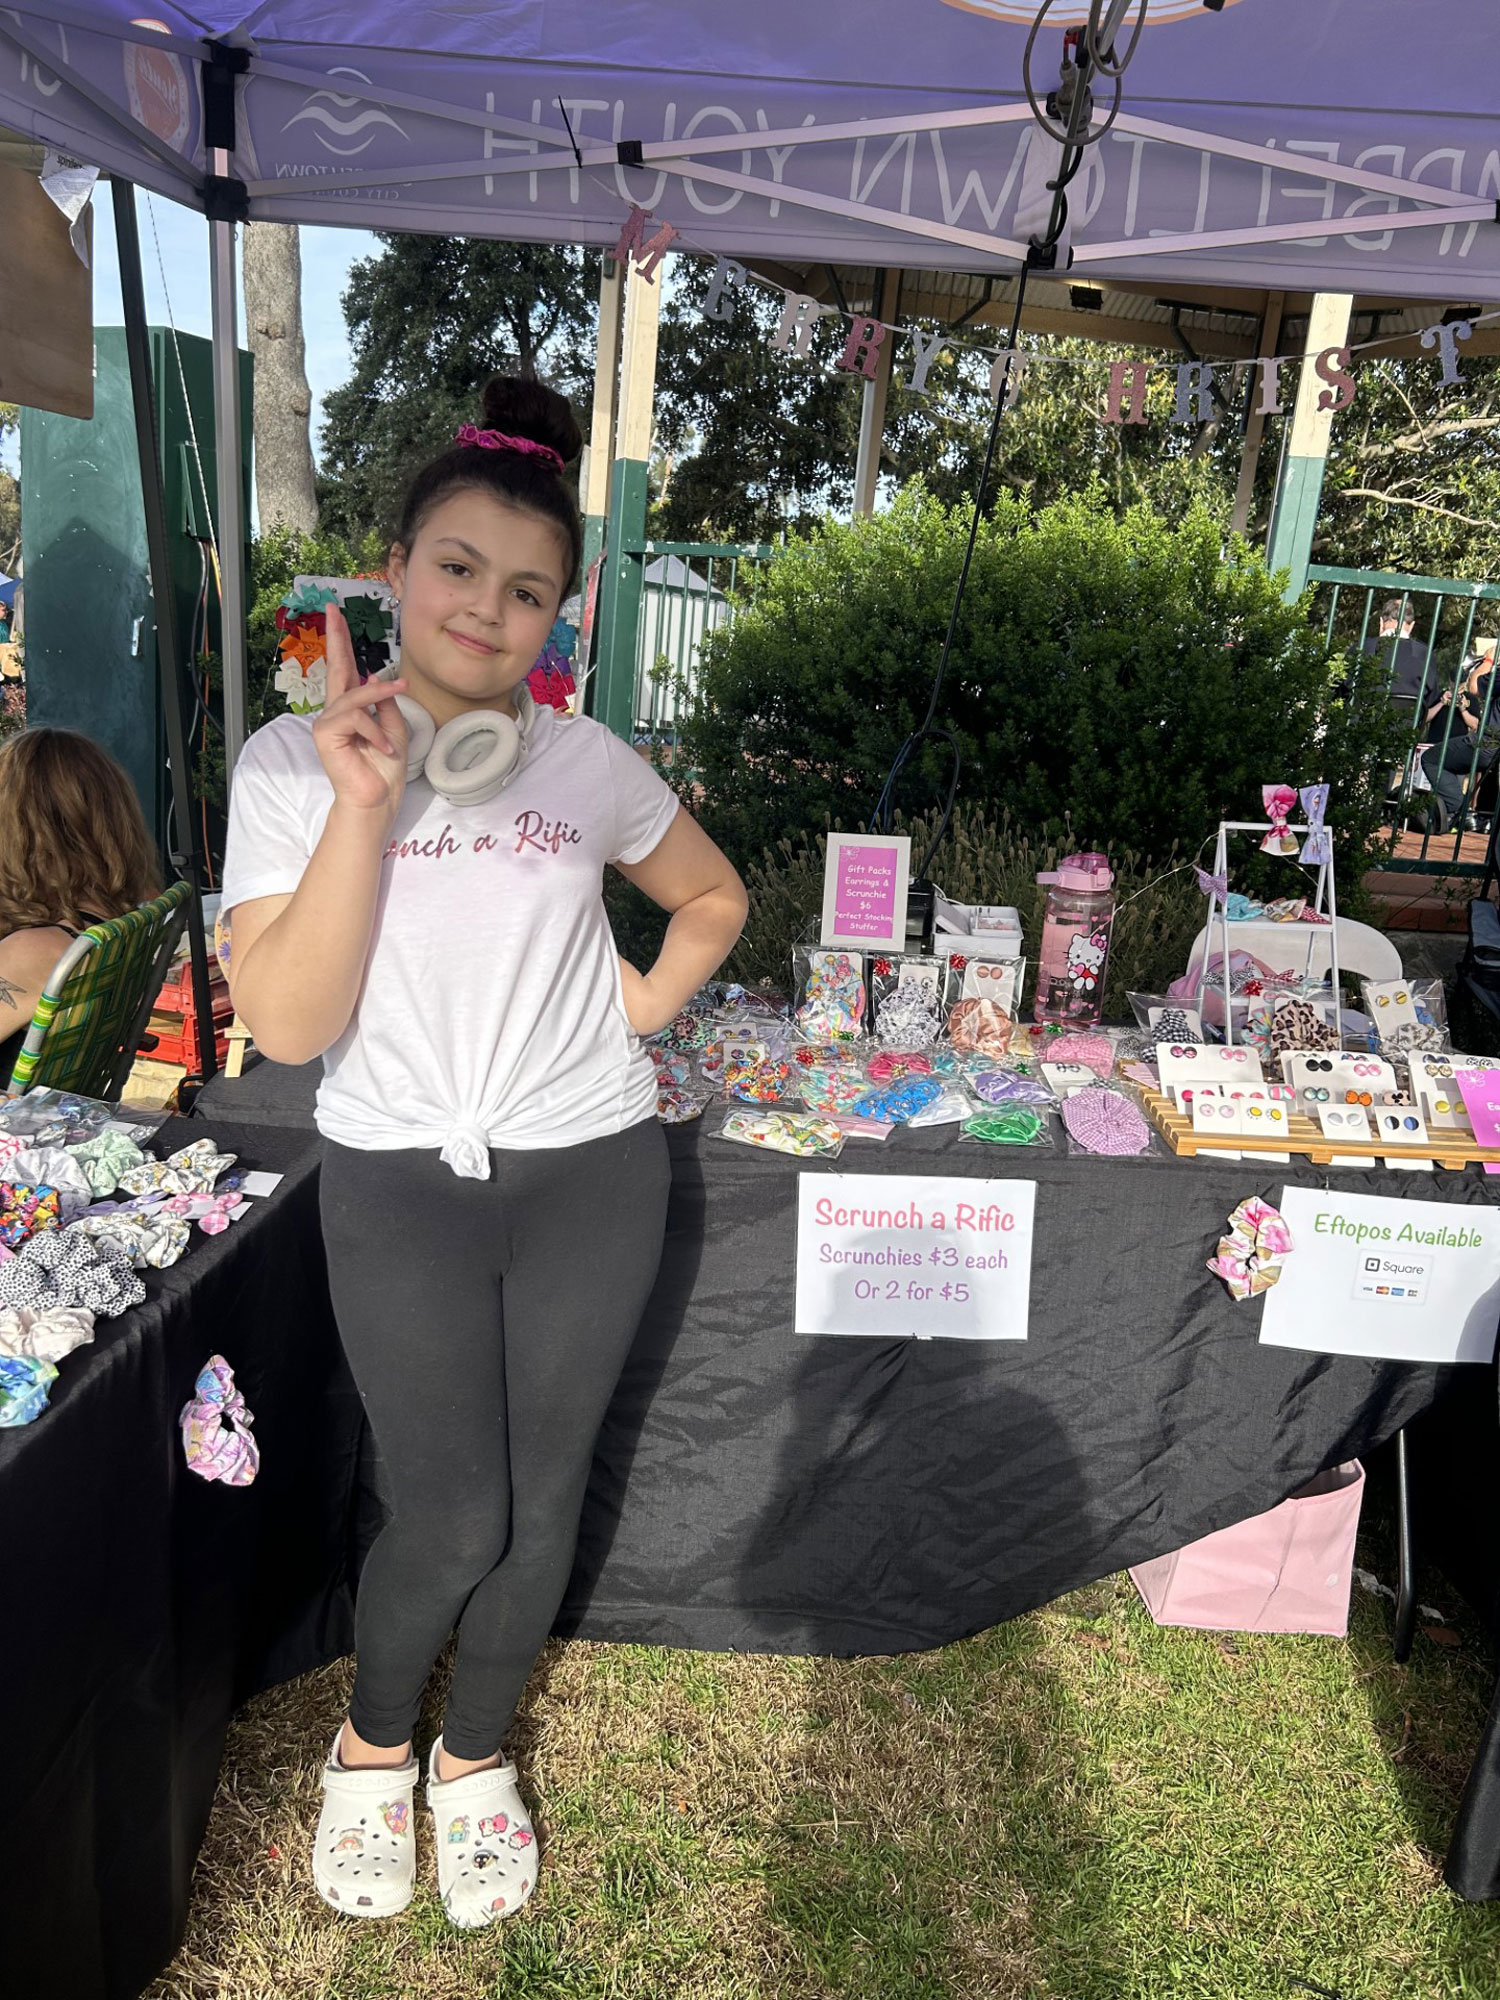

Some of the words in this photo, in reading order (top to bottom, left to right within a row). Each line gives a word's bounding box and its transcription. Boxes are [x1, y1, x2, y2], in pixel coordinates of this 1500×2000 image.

[608, 202, 948, 396] MERRY
[989, 320, 1473, 425] CHRIST
[382, 823, 462, 860] unch
[473, 833, 498, 853] a
[514, 810, 582, 854] Rific
[848, 864, 866, 874] Gift
[868, 865, 892, 875] Packs
[845, 876, 880, 888] Earrings
[883, 879, 889, 887] &
[845, 889, 887, 899] Scrunchie
[859, 901, 872, 910] $6
[850, 922, 879, 931] Stuffer
[815, 1198, 923, 1230] Scrunch
[930, 1212, 946, 1230] a
[954, 1203, 1015, 1232] Rific
[1314, 1213, 1392, 1244] Eftopos
[1397, 1222, 1483, 1248] Available
[819, 1243, 922, 1266] Scrunchies
[928, 1246, 959, 1267] $3
[965, 1250, 1008, 1269] each
[1382, 1260, 1425, 1275] Square
[854, 1279, 880, 1299] Or
[885, 1280, 901, 1300] 2
[906, 1280, 934, 1300] for
[939, 1282, 970, 1303] $5
